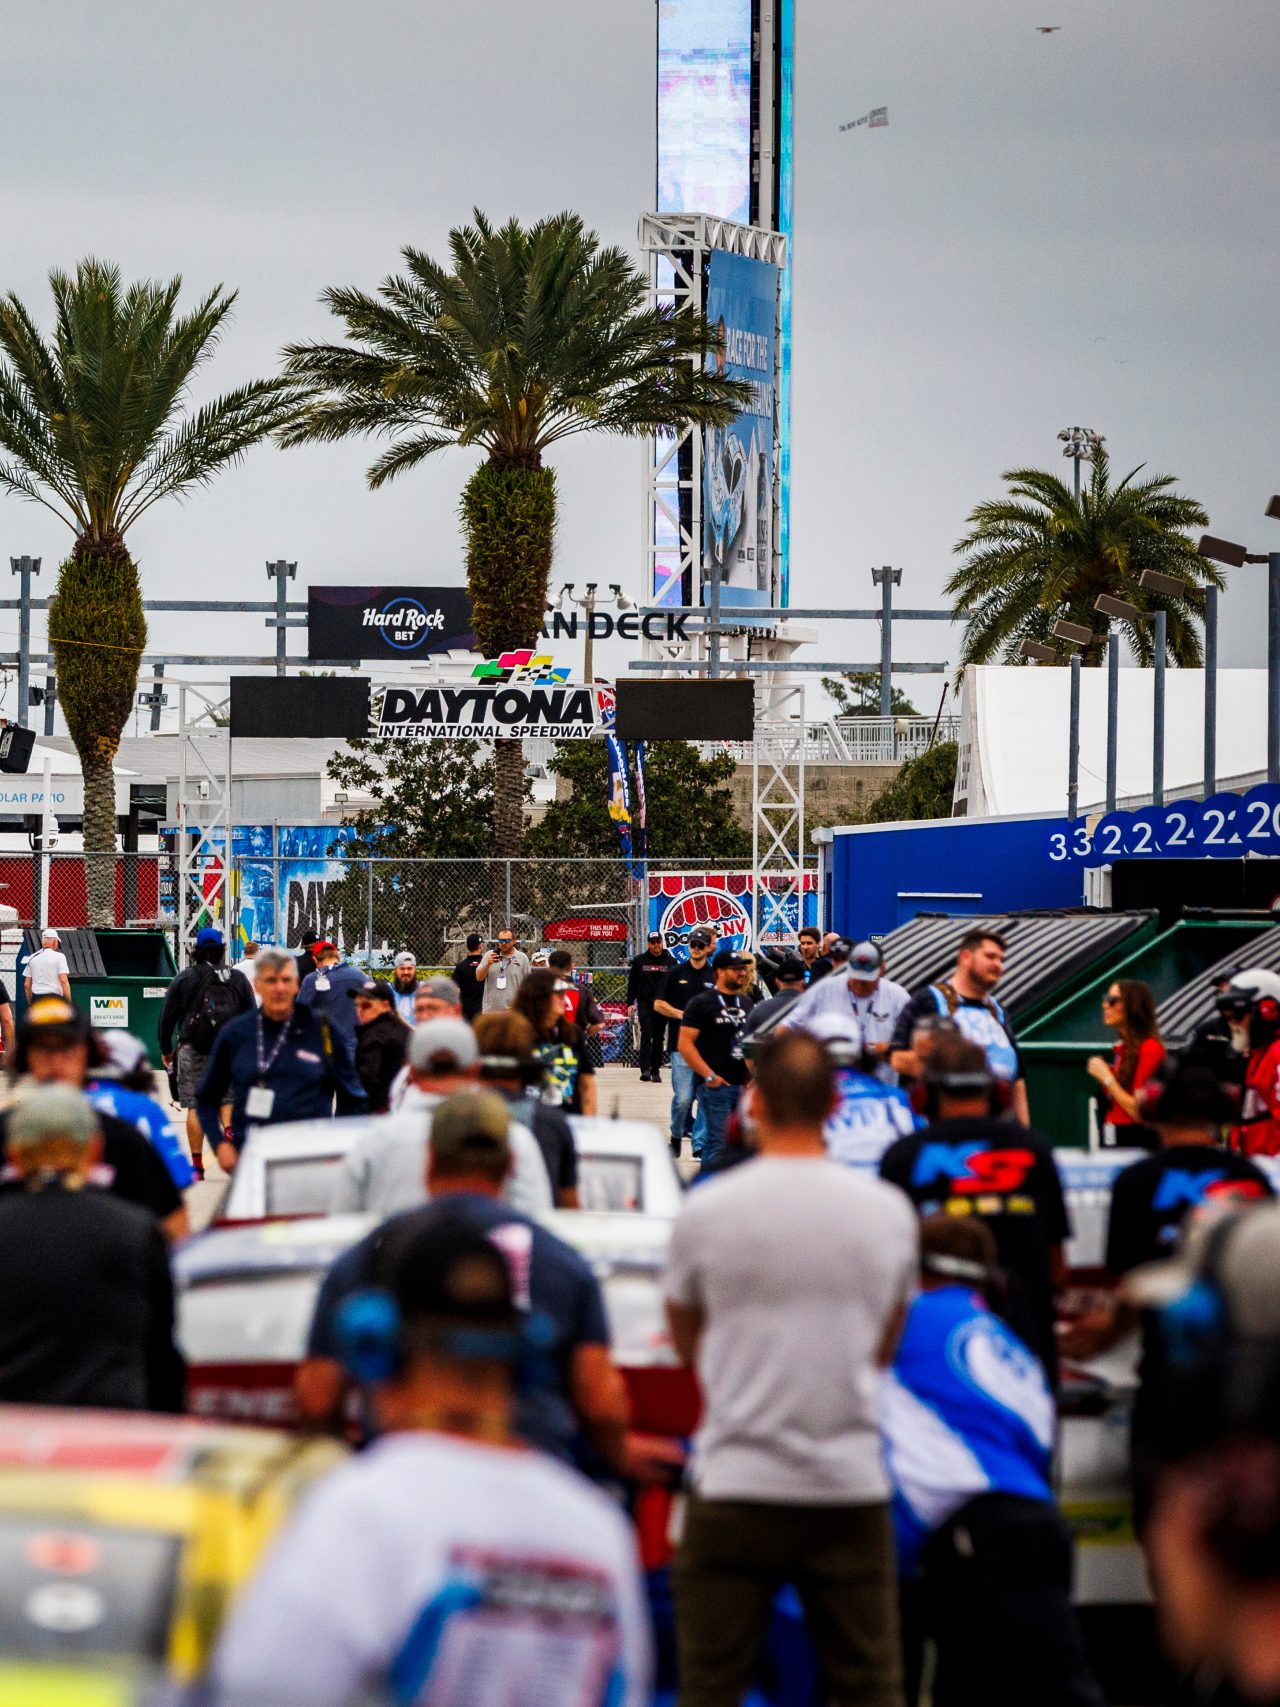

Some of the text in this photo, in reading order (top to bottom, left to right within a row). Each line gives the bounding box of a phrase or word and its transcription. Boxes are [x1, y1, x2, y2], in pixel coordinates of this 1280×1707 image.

[744, 331, 755, 368] FOR
[757, 335, 768, 371] THE
[363, 608, 444, 631] Hard Rock
[589, 612, 691, 642] DECK
[394, 631, 415, 642] BET
[381, 689, 593, 724] DAYTONA
[378, 725, 594, 738] INTERNATIONAL SPEEDWAY
[32, 793, 64, 802] PAIO
[1203, 810, 1243, 844] 2
[1247, 801, 1280, 838] 2
[664, 917, 746, 948] DoNV
[94, 999, 124, 1009] WM
